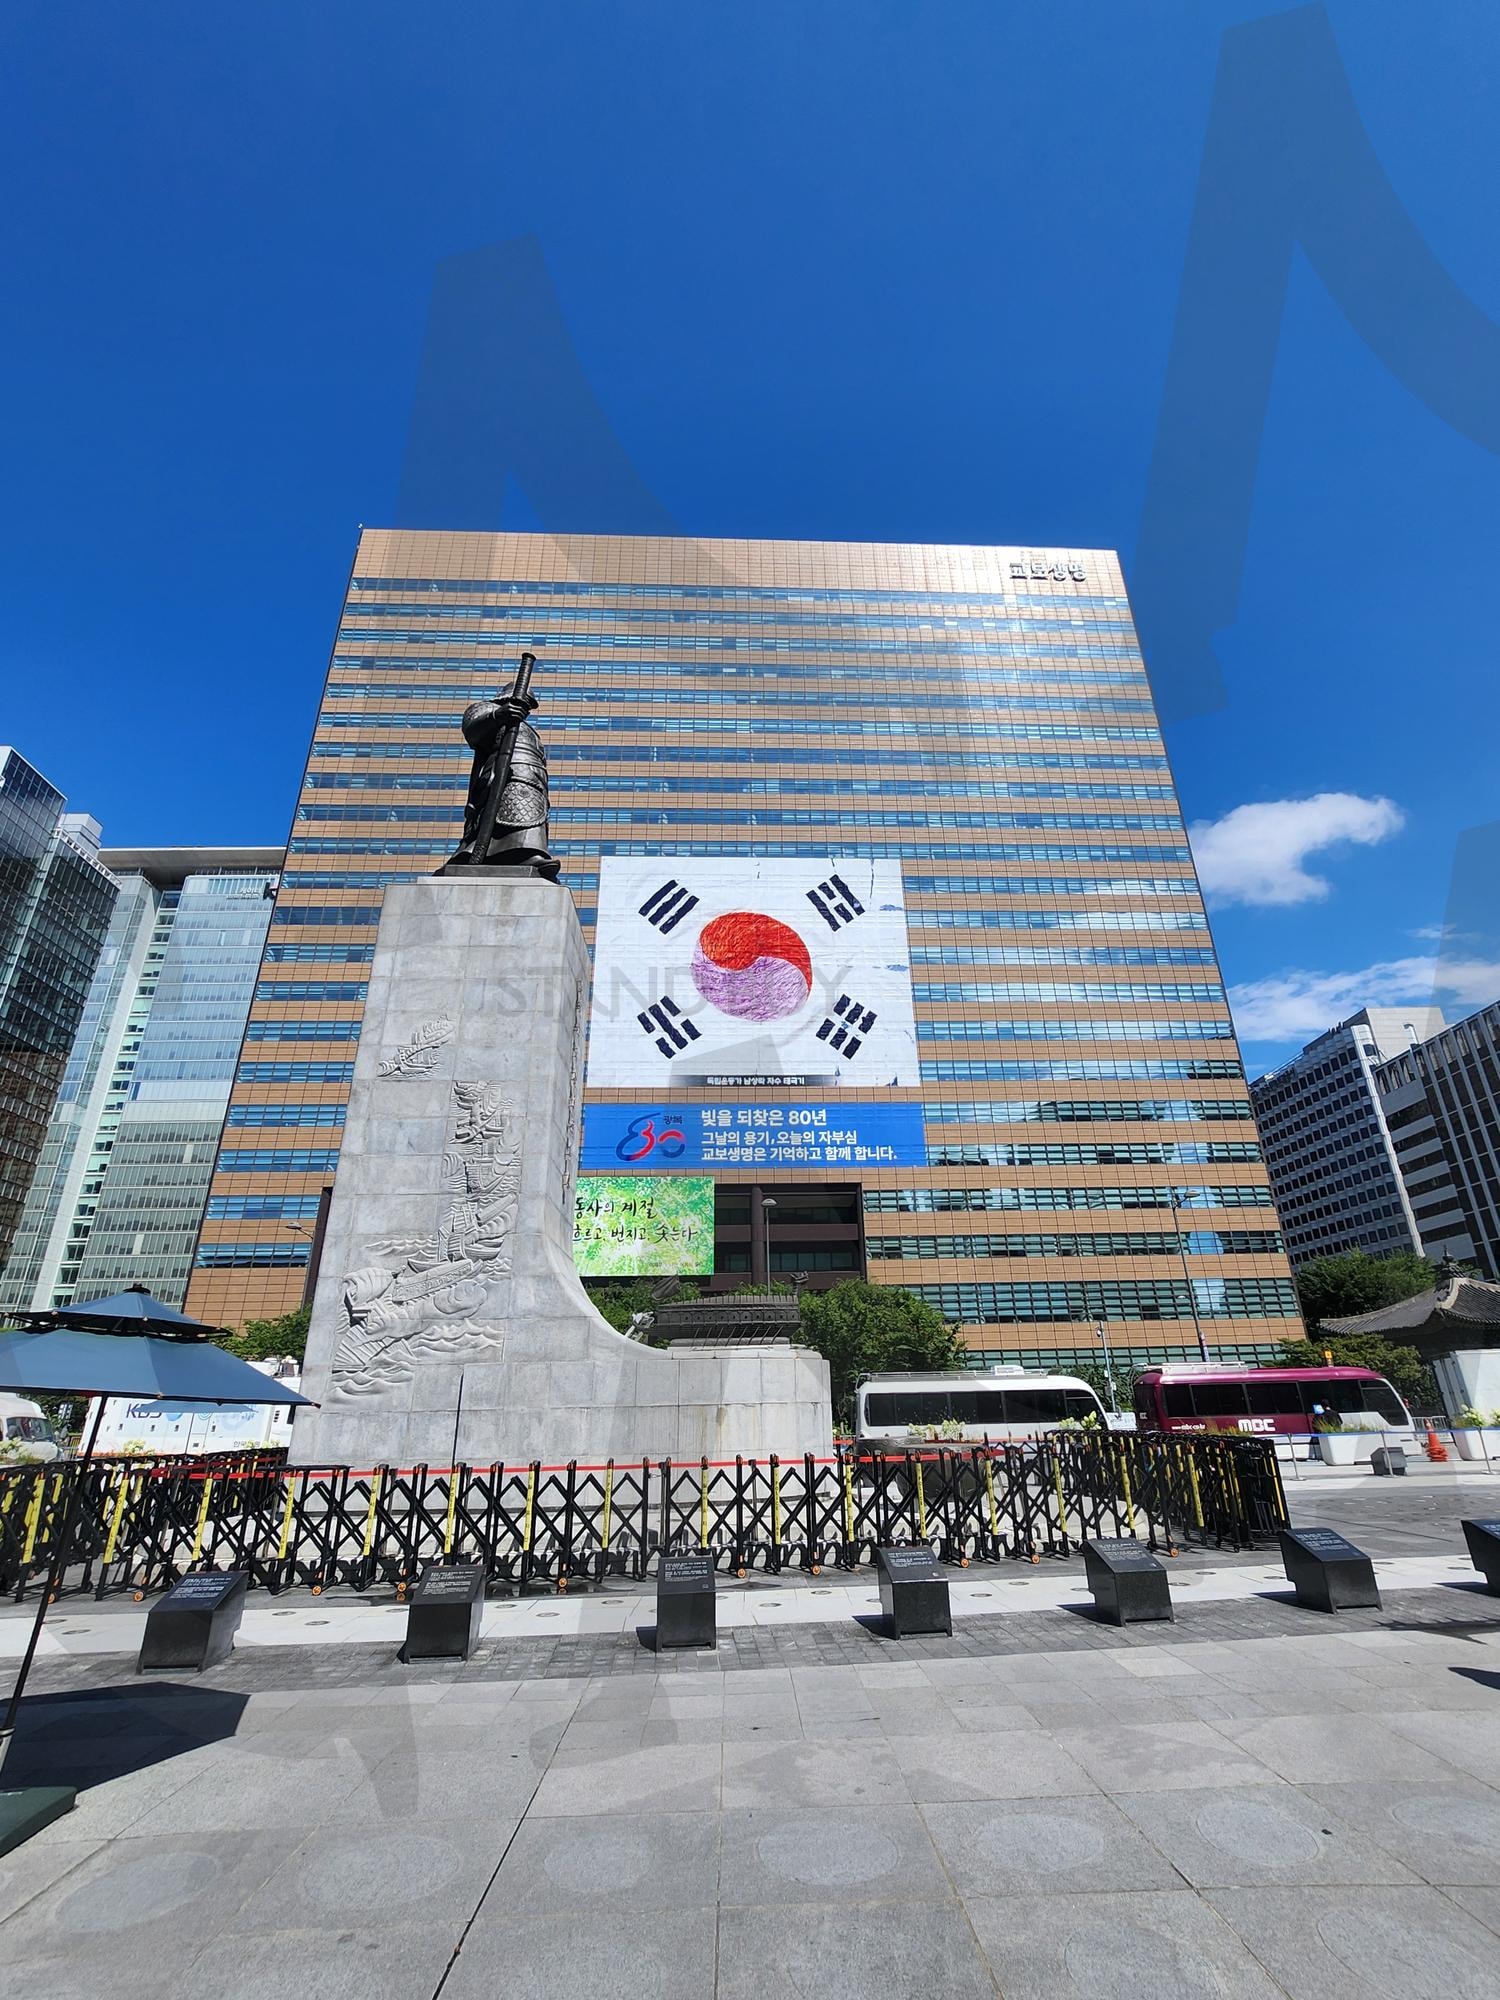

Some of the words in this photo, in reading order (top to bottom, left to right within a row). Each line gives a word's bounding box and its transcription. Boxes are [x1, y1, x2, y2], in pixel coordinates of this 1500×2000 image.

[767, 1076, 781, 1085] 자수
[783, 1076, 805, 1085] 태극기
[701, 1109, 733, 1126] 빛을
[737, 1109, 784, 1126] 되찾은
[788, 1109, 827, 1126] 80년
[701, 1131, 740, 1145] 그날의
[777, 1131, 815, 1145] 오늘의
[819, 1130, 857, 1145] 자부심
[701, 1147, 767, 1161] 교보생명은
[770, 1147, 822, 1161] 기억하고
[825, 1146, 851, 1160] 함께
[854, 1146, 898, 1160] 합니다.
[574, 1197, 614, 1219] 동사의
[621, 1197, 658, 1219] 계절
[654, 1224, 698, 1243] 솟는다
[1238, 1418, 1276, 1432] MBC
